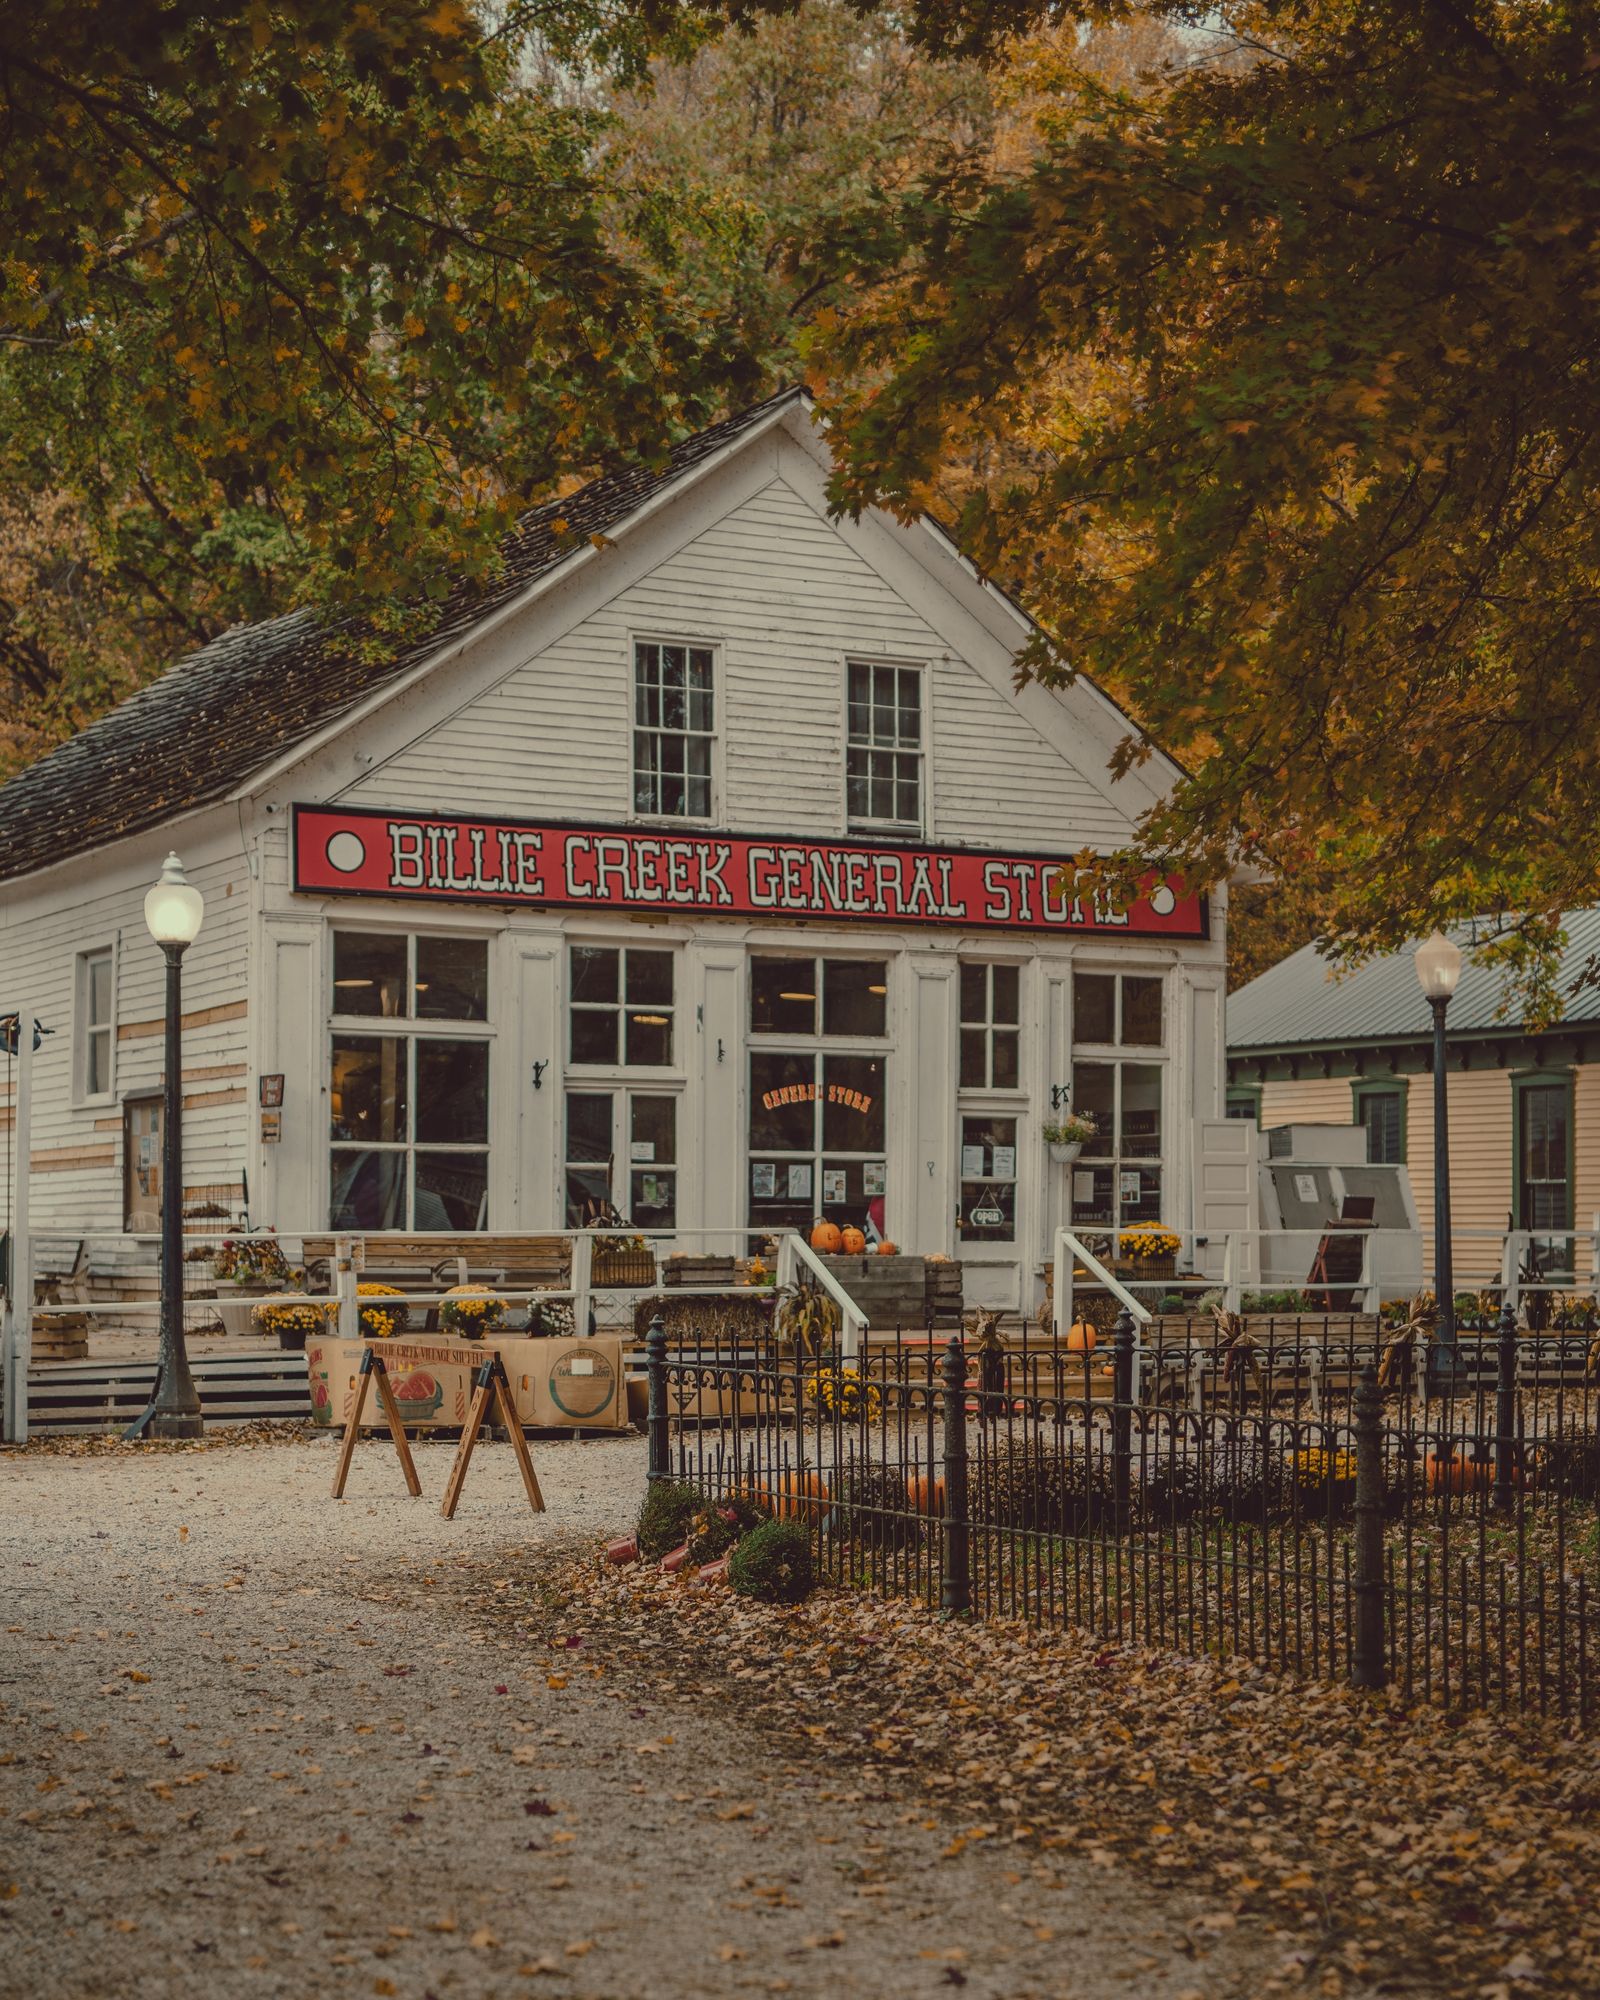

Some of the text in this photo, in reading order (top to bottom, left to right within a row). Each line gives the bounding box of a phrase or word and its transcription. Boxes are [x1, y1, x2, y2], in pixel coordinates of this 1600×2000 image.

[388, 822, 544, 896] BILLIE
[564, 834, 733, 905] CREEK
[747, 846, 966, 919] GENERAL
[828, 1085, 872, 1113] STORE
[397, 1344, 419, 1359] CREEK
[420, 1346, 450, 1363] VILLAGE
